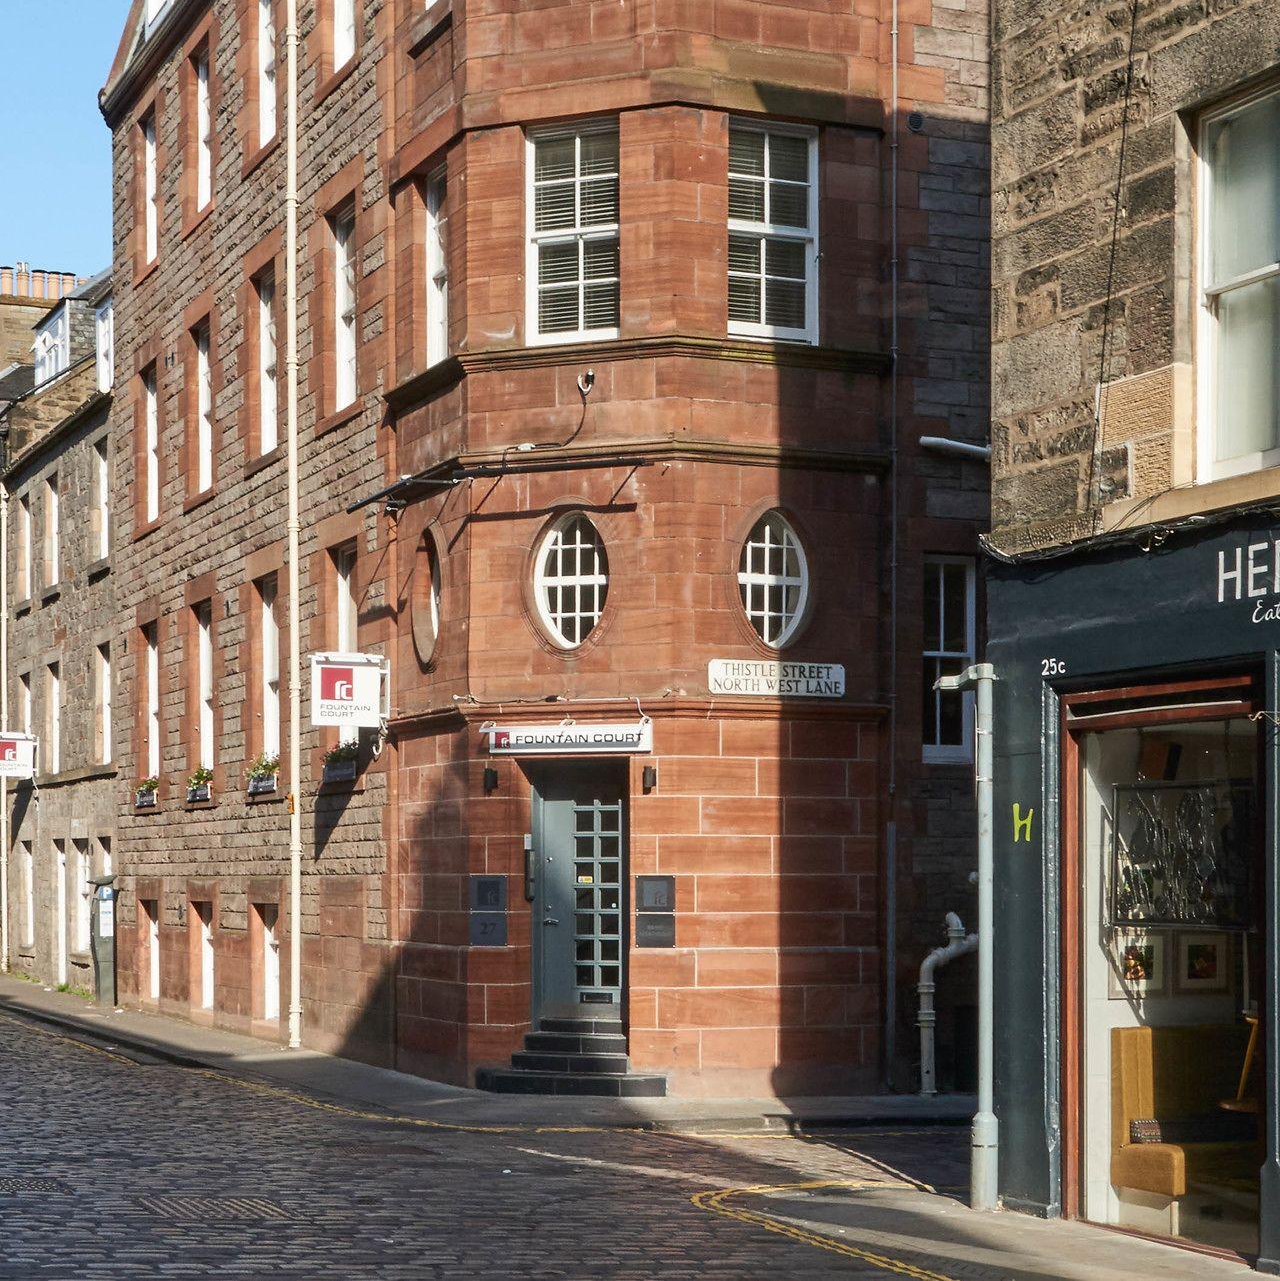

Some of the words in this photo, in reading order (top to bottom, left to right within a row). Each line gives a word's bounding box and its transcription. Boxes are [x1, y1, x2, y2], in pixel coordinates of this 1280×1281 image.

[721, 662, 776, 677] THISTLE
[782, 664, 833, 679] STREET
[1041, 658, 1066, 676] 25c
[713, 677, 760, 692] NORTH
[766, 679, 801, 693] WEST
[806, 680, 841, 694] LANE
[320, 703, 371, 711] FOUNTAIN
[320, 710, 354, 718] COURT
[515, 733, 589, 744] FOUNTAIN
[593, 732, 644, 743] COURT
[1012, 803, 1034, 842] H
[480, 922, 497, 936] 27
